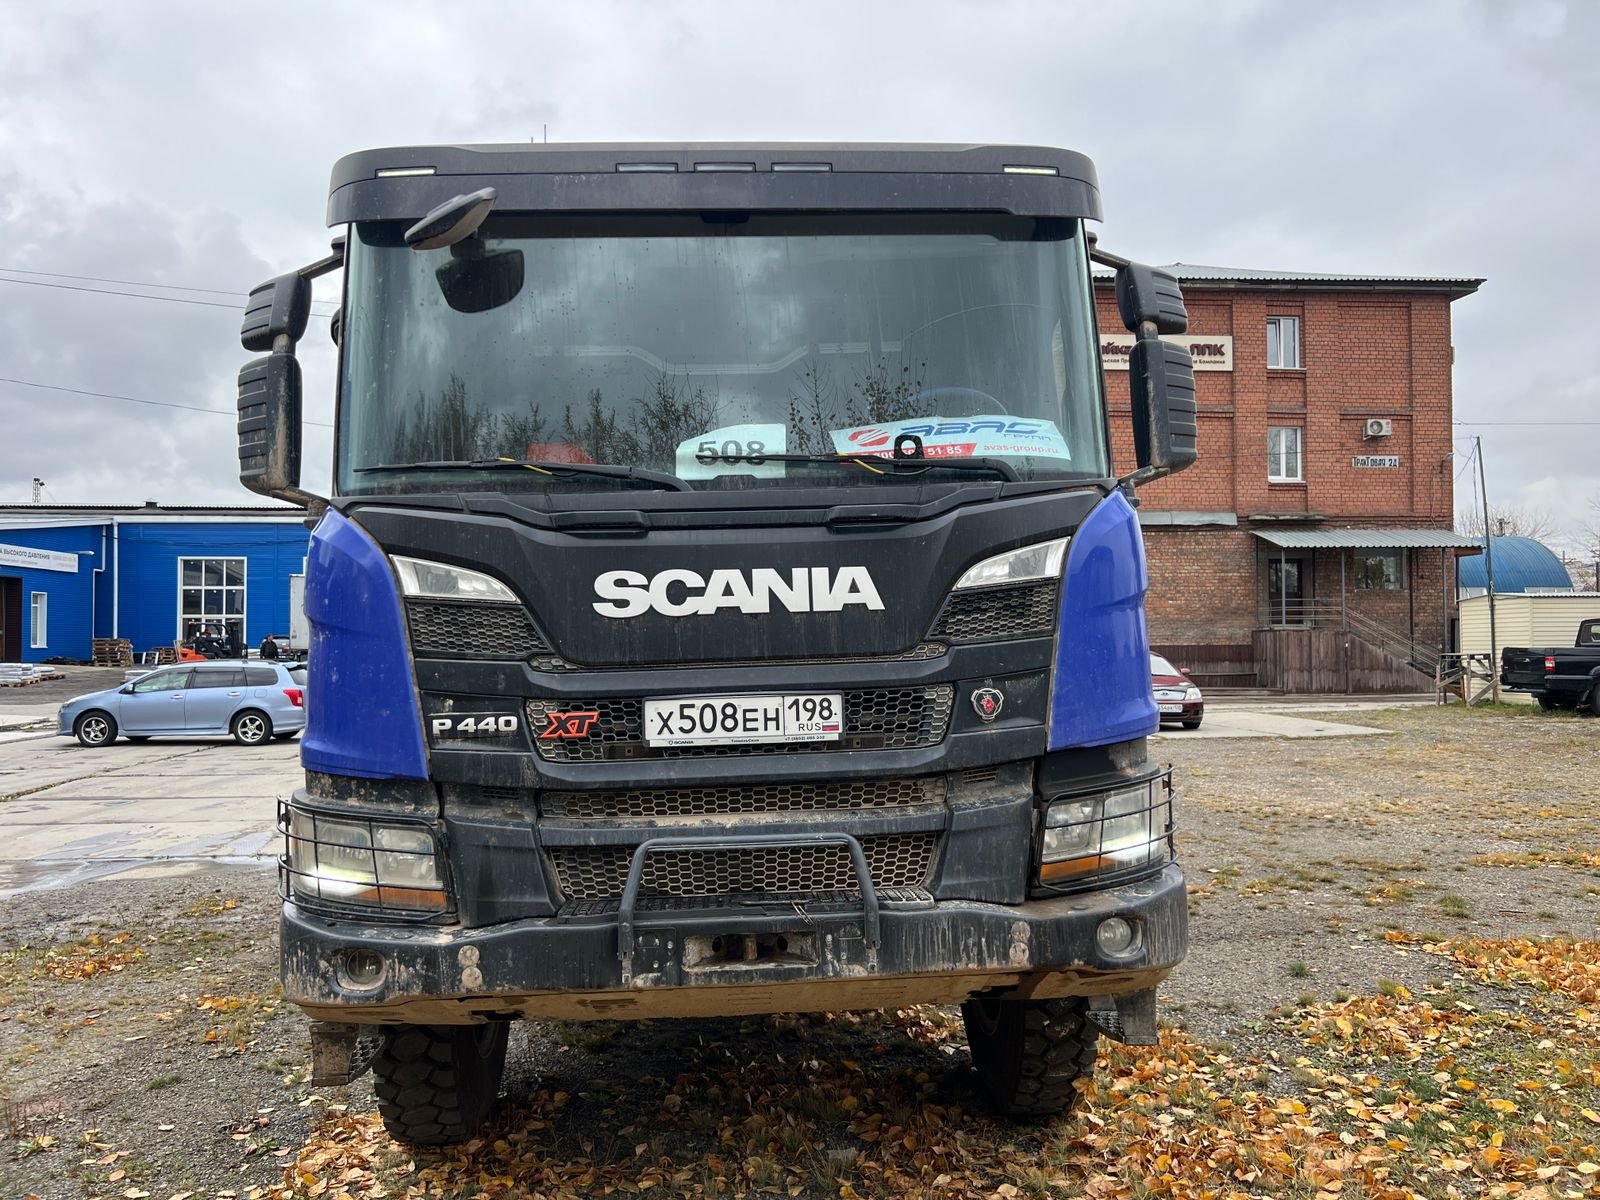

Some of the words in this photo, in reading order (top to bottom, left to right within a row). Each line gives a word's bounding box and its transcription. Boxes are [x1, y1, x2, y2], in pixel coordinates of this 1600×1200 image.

[1189, 343, 1226, 356] ППК
[697, 440, 766, 466] 508
[927, 447, 942, 456] 51
[946, 445, 962, 454] 85
[983, 443, 1060, 454] avas-group.ru
[592, 565, 886, 619] SCANIA
[787, 697, 832, 722] 198
[432, 718, 452, 735] P
[457, 716, 518, 733] 440
[539, 711, 599, 739] XT
[798, 722, 821, 732] RUS
